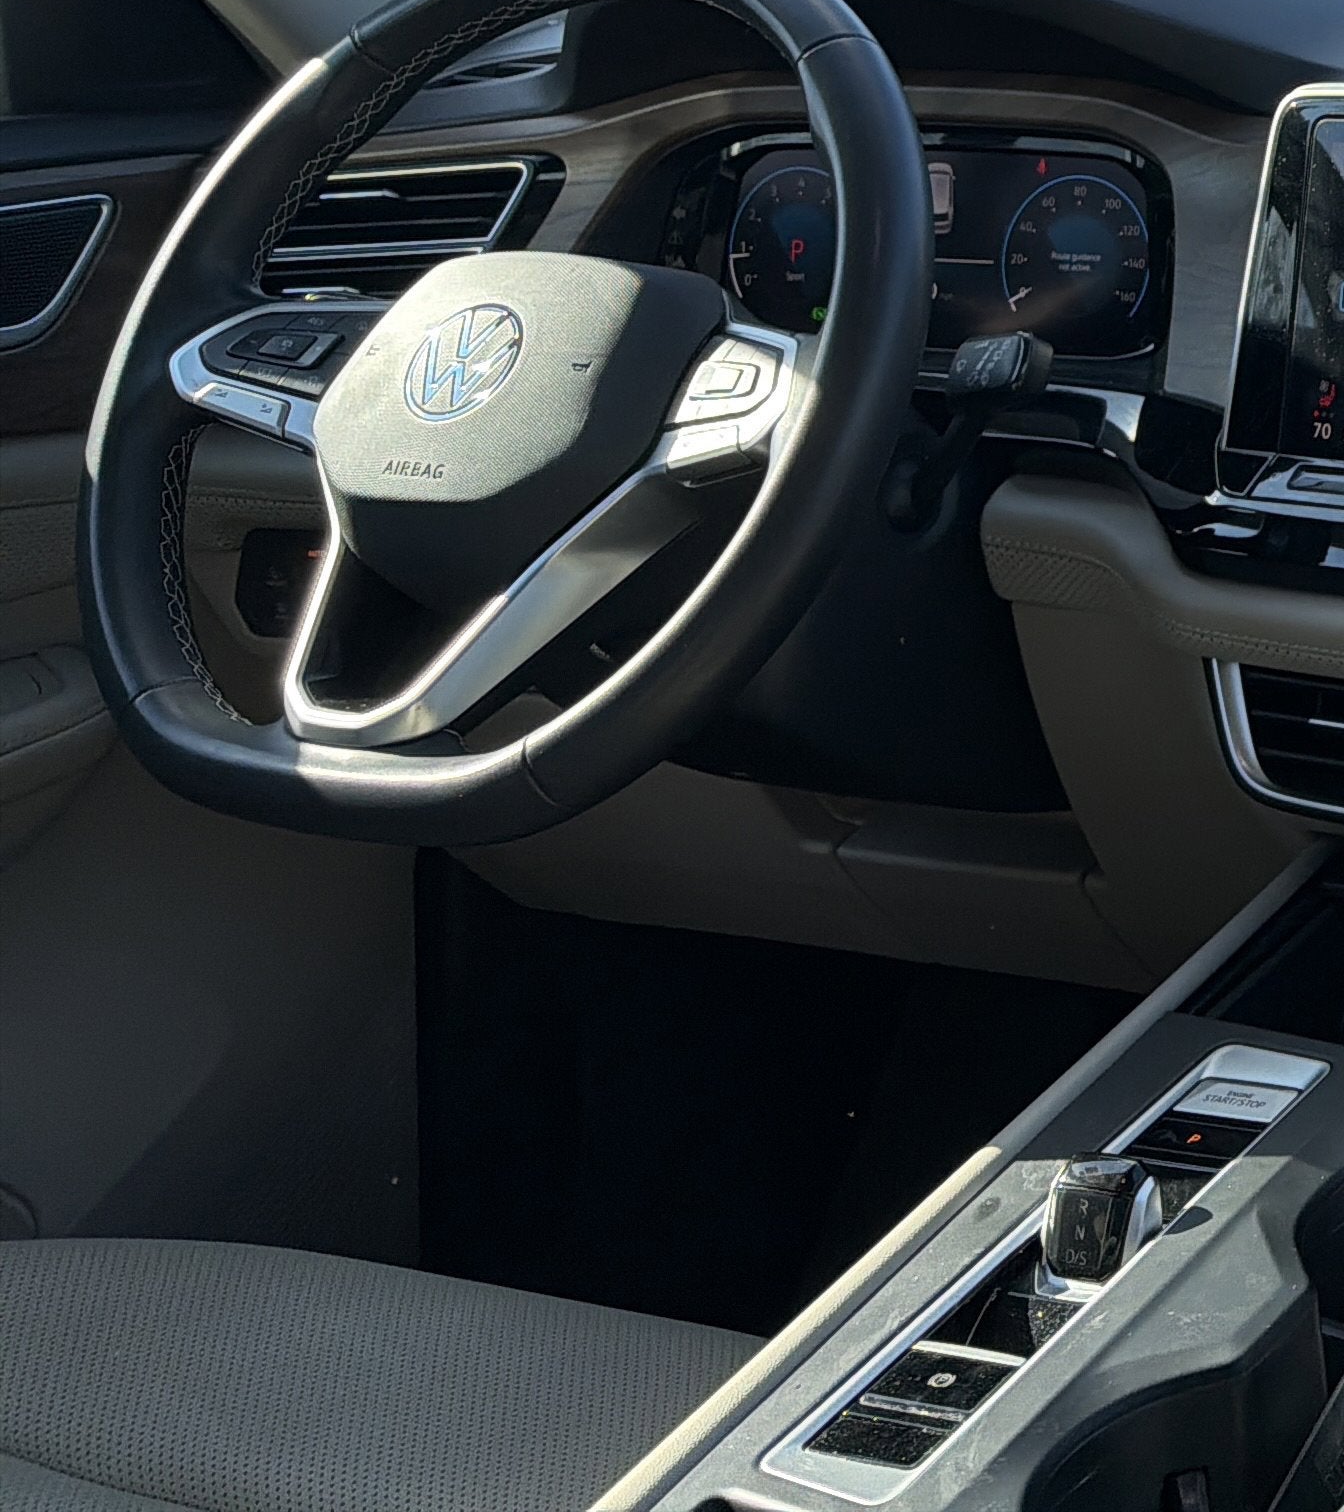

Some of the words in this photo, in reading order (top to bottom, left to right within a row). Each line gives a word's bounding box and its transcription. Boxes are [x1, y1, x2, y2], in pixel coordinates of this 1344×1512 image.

[1074, 186, 1087, 198] 80
[1042, 196, 1056, 208] 60
[1104, 198, 1122, 210] 100
[1019, 221, 1033, 232] 40
[1123, 225, 1140, 237] 120
[790, 239, 804, 263] P
[1010, 253, 1024, 264] 20
[1128, 257, 1145, 269] 140
[1119, 291, 1136, 302] 160
[1312, 421, 1332, 440] 70
[381, 460, 445, 480] AIRBAG
[1202, 1094, 1267, 1108] START/STOP
[1079, 1198, 1089, 1217] R
[1074, 1224, 1086, 1240] N
[1065, 1249, 1087, 1266] D/S
